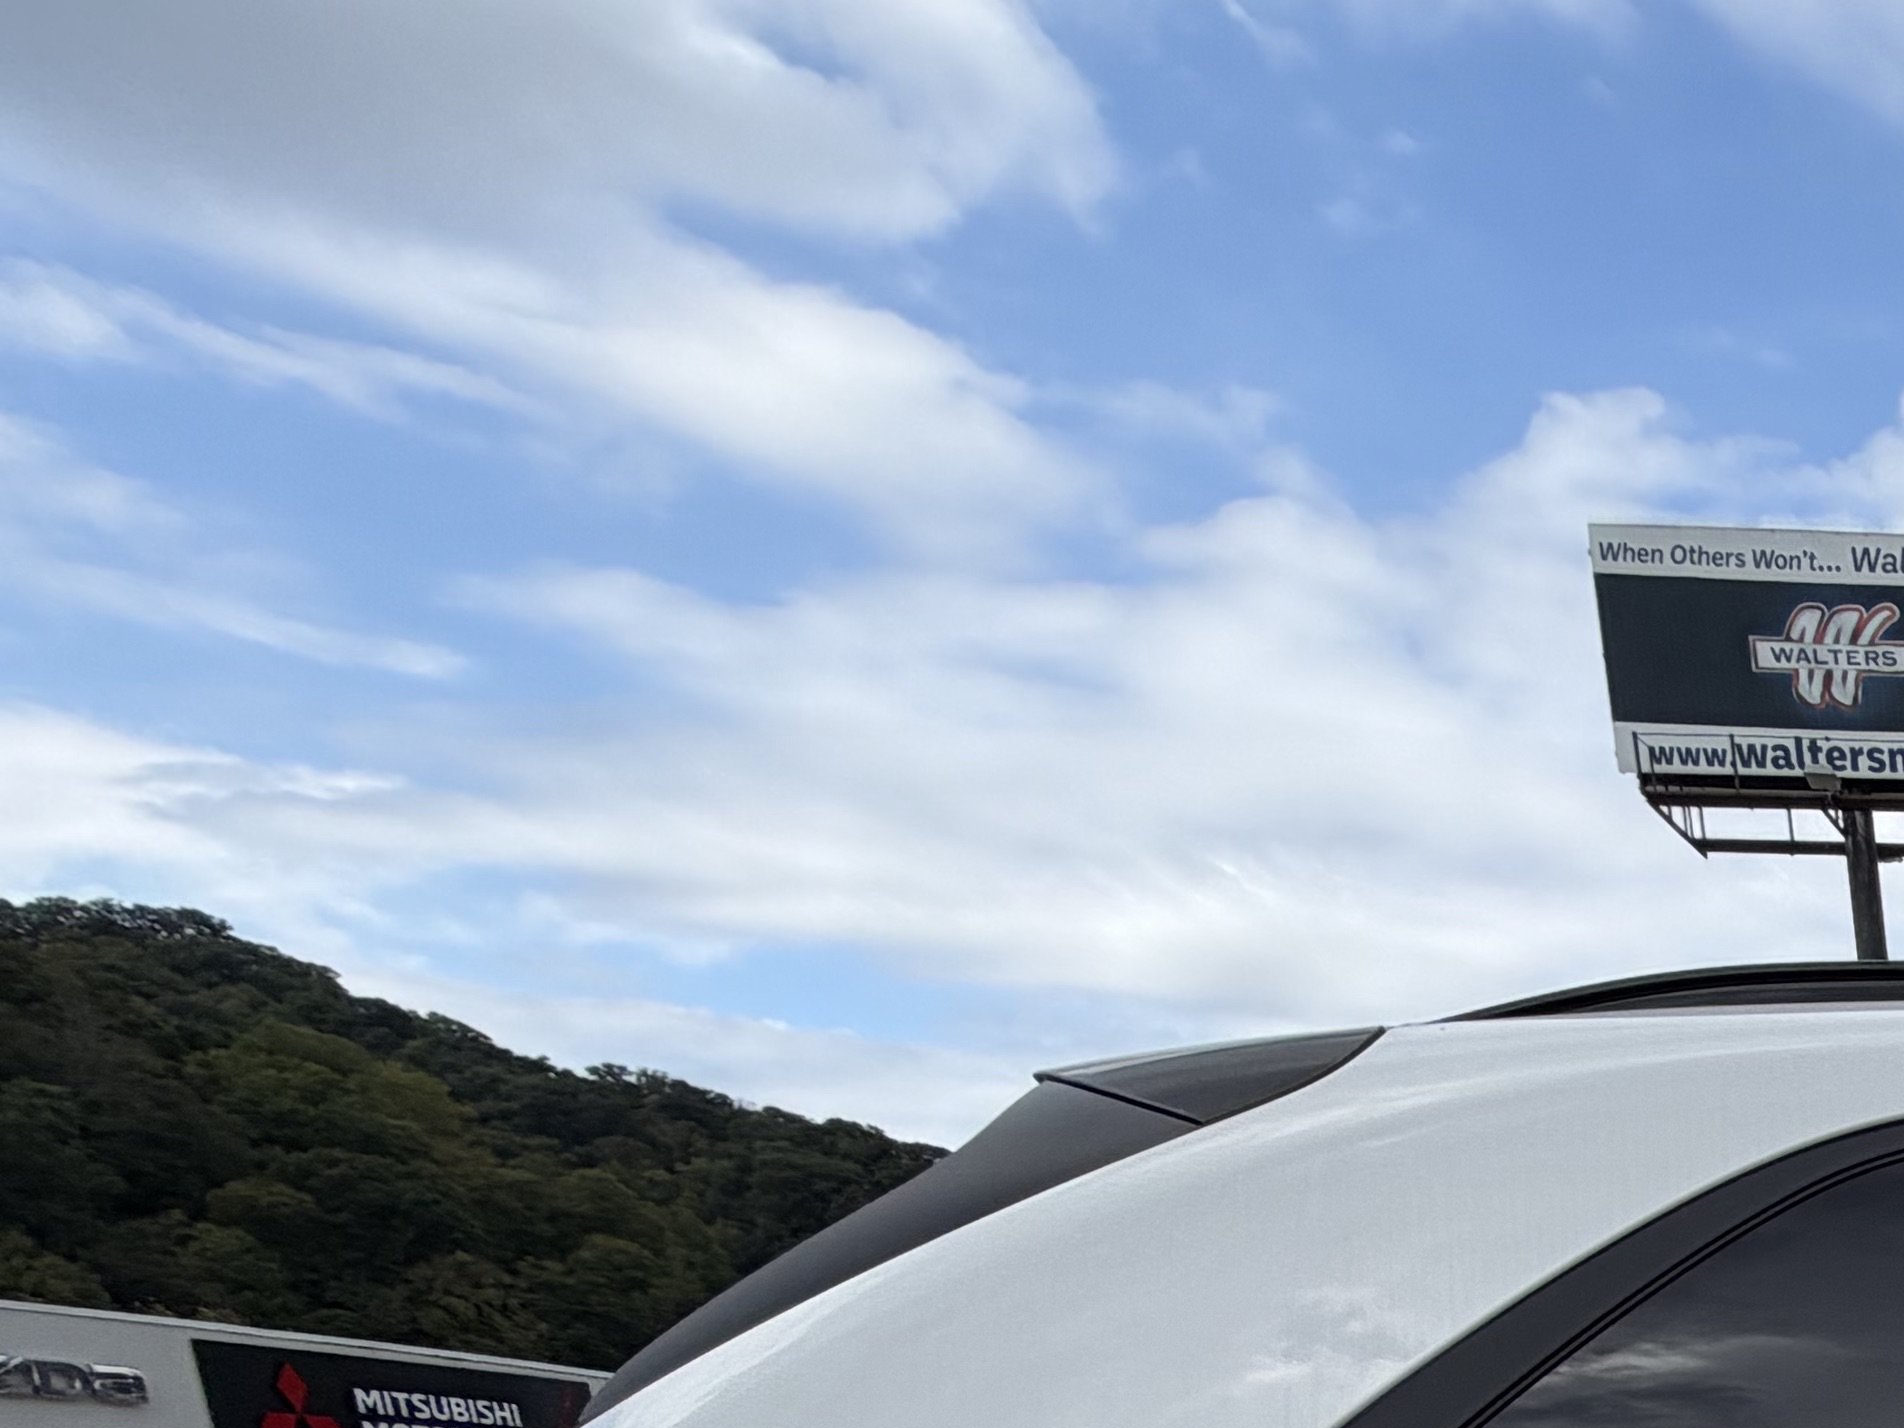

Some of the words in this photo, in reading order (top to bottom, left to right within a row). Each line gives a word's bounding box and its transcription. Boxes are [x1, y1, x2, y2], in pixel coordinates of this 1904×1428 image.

[1598, 541, 1664, 565] When
[1670, 544, 1747, 569] Others
[1752, 548, 1842, 573] Won't...
[1770, 646, 1898, 667] WALTERS
[352, 1387, 524, 1428] MITSUBISHI
